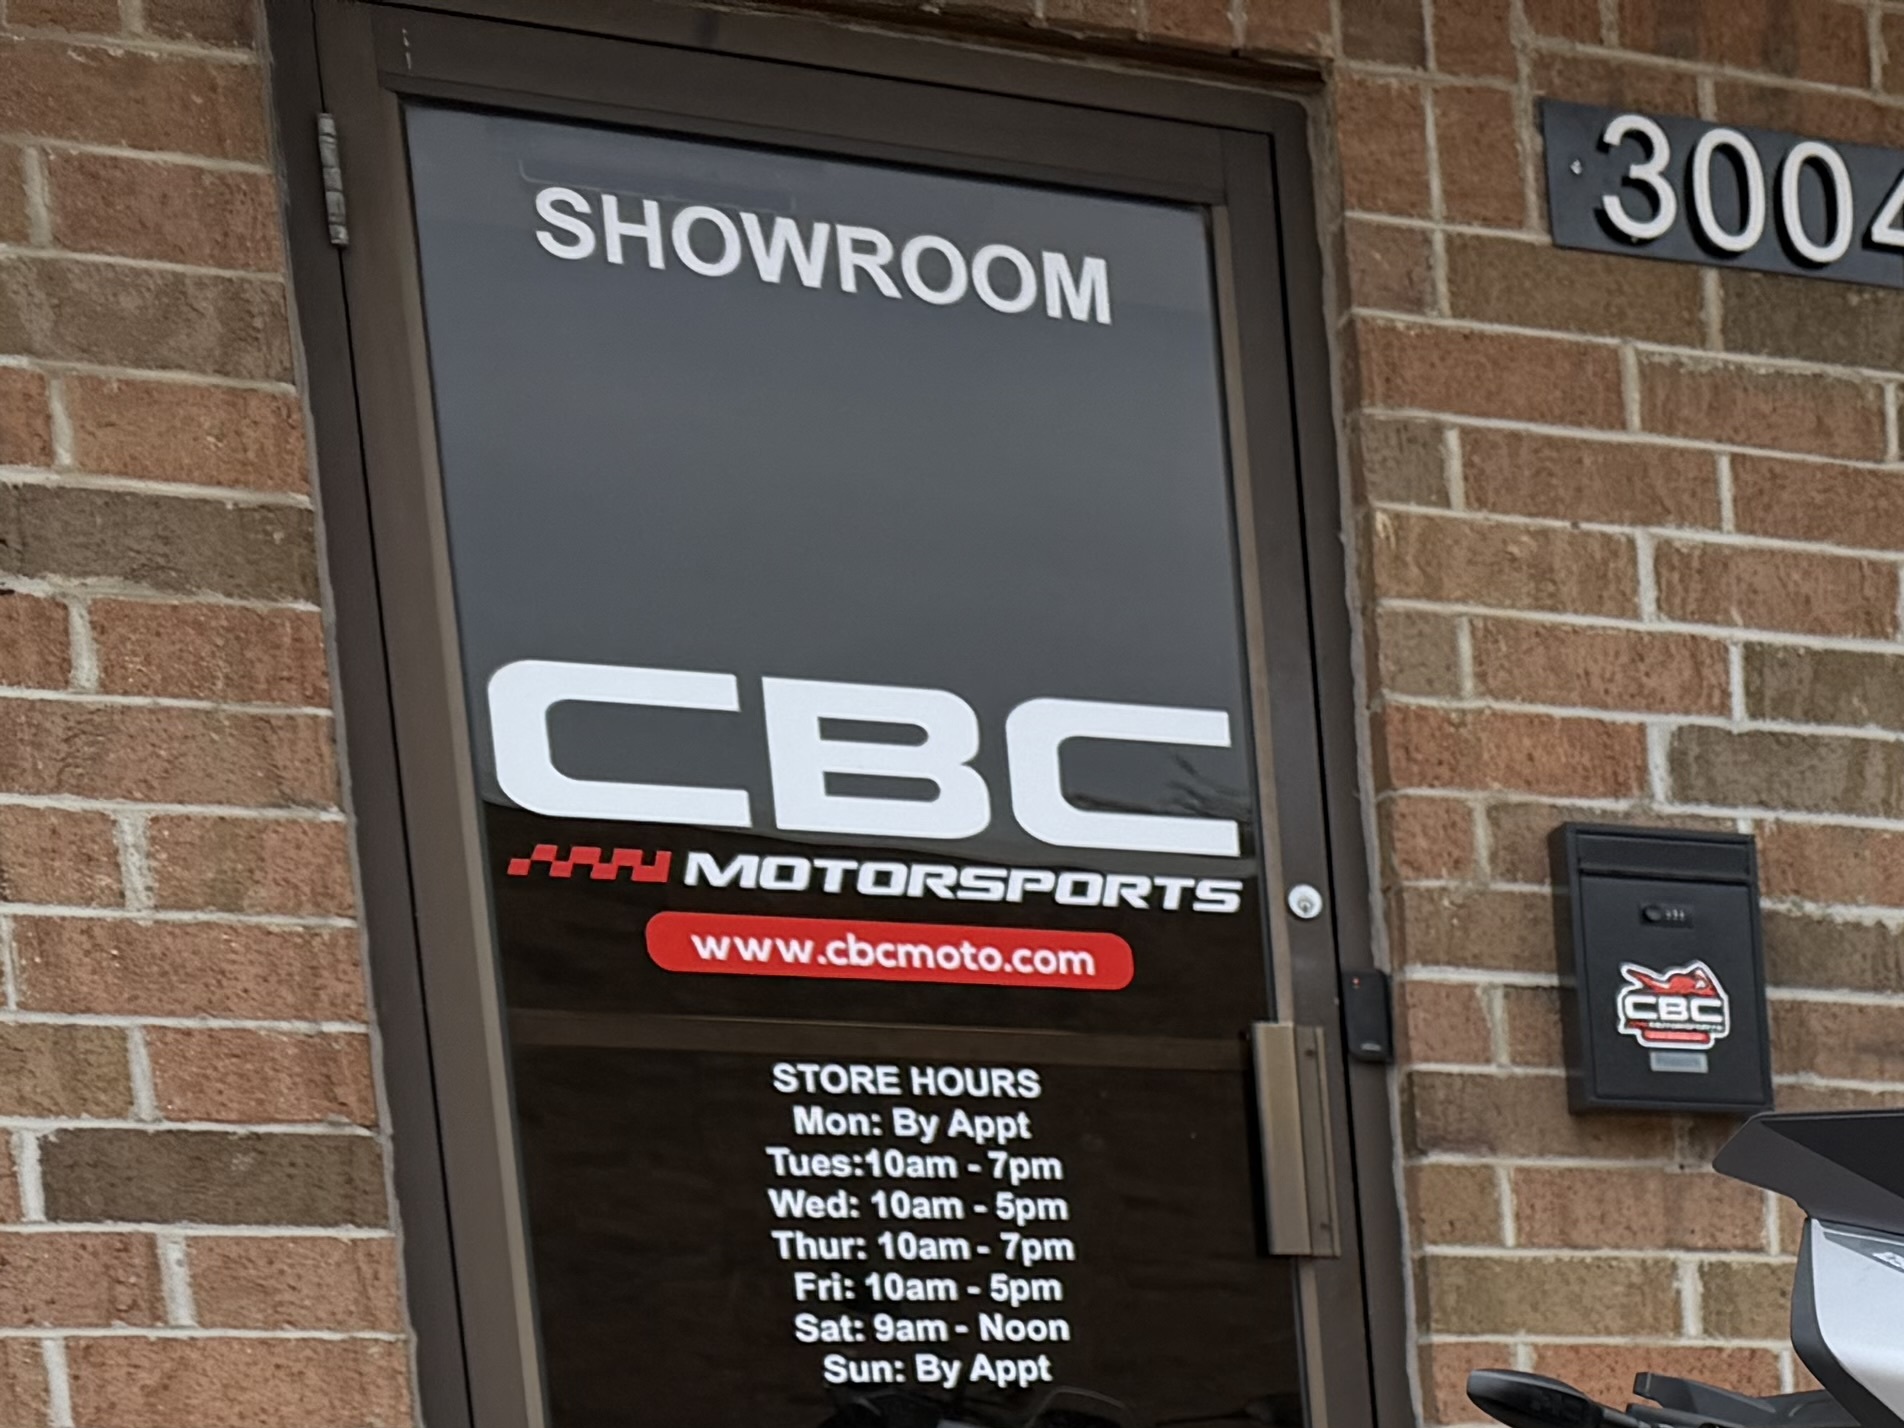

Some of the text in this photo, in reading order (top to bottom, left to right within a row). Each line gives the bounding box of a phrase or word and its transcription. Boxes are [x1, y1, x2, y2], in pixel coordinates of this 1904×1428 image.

[534, 184, 1113, 326] SHOWROOM
[486, 658, 1242, 858] CBC
[682, 850, 1244, 914] MOTORSPORTS
[689, 930, 1097, 978] www.cbcmoto.com
[1625, 995, 1724, 1024] CBC
[772, 1062, 1043, 1099] STORE HOURS
[792, 1105, 1033, 1145] Mon: By Appt
[987, 1150, 1064, 1186] 7pm
[766, 1187, 862, 1219] Wed:
[870, 1189, 966, 1220] 10am
[995, 1191, 1070, 1227] 5pm
[770, 1229, 868, 1260] Thur:
[877, 1230, 971, 1261] 10am
[999, 1231, 1076, 1267] 7pm
[793, 1272, 857, 1301] Fri:
[864, 1272, 959, 1302] 10am
[989, 1273, 1064, 1308] 5pm
[793, 1313, 866, 1343] Sat:
[873, 1313, 950, 1343] 9am
[977, 1312, 1072, 1342] Noon
[823, 1353, 1054, 1389] Sun: By Appt
